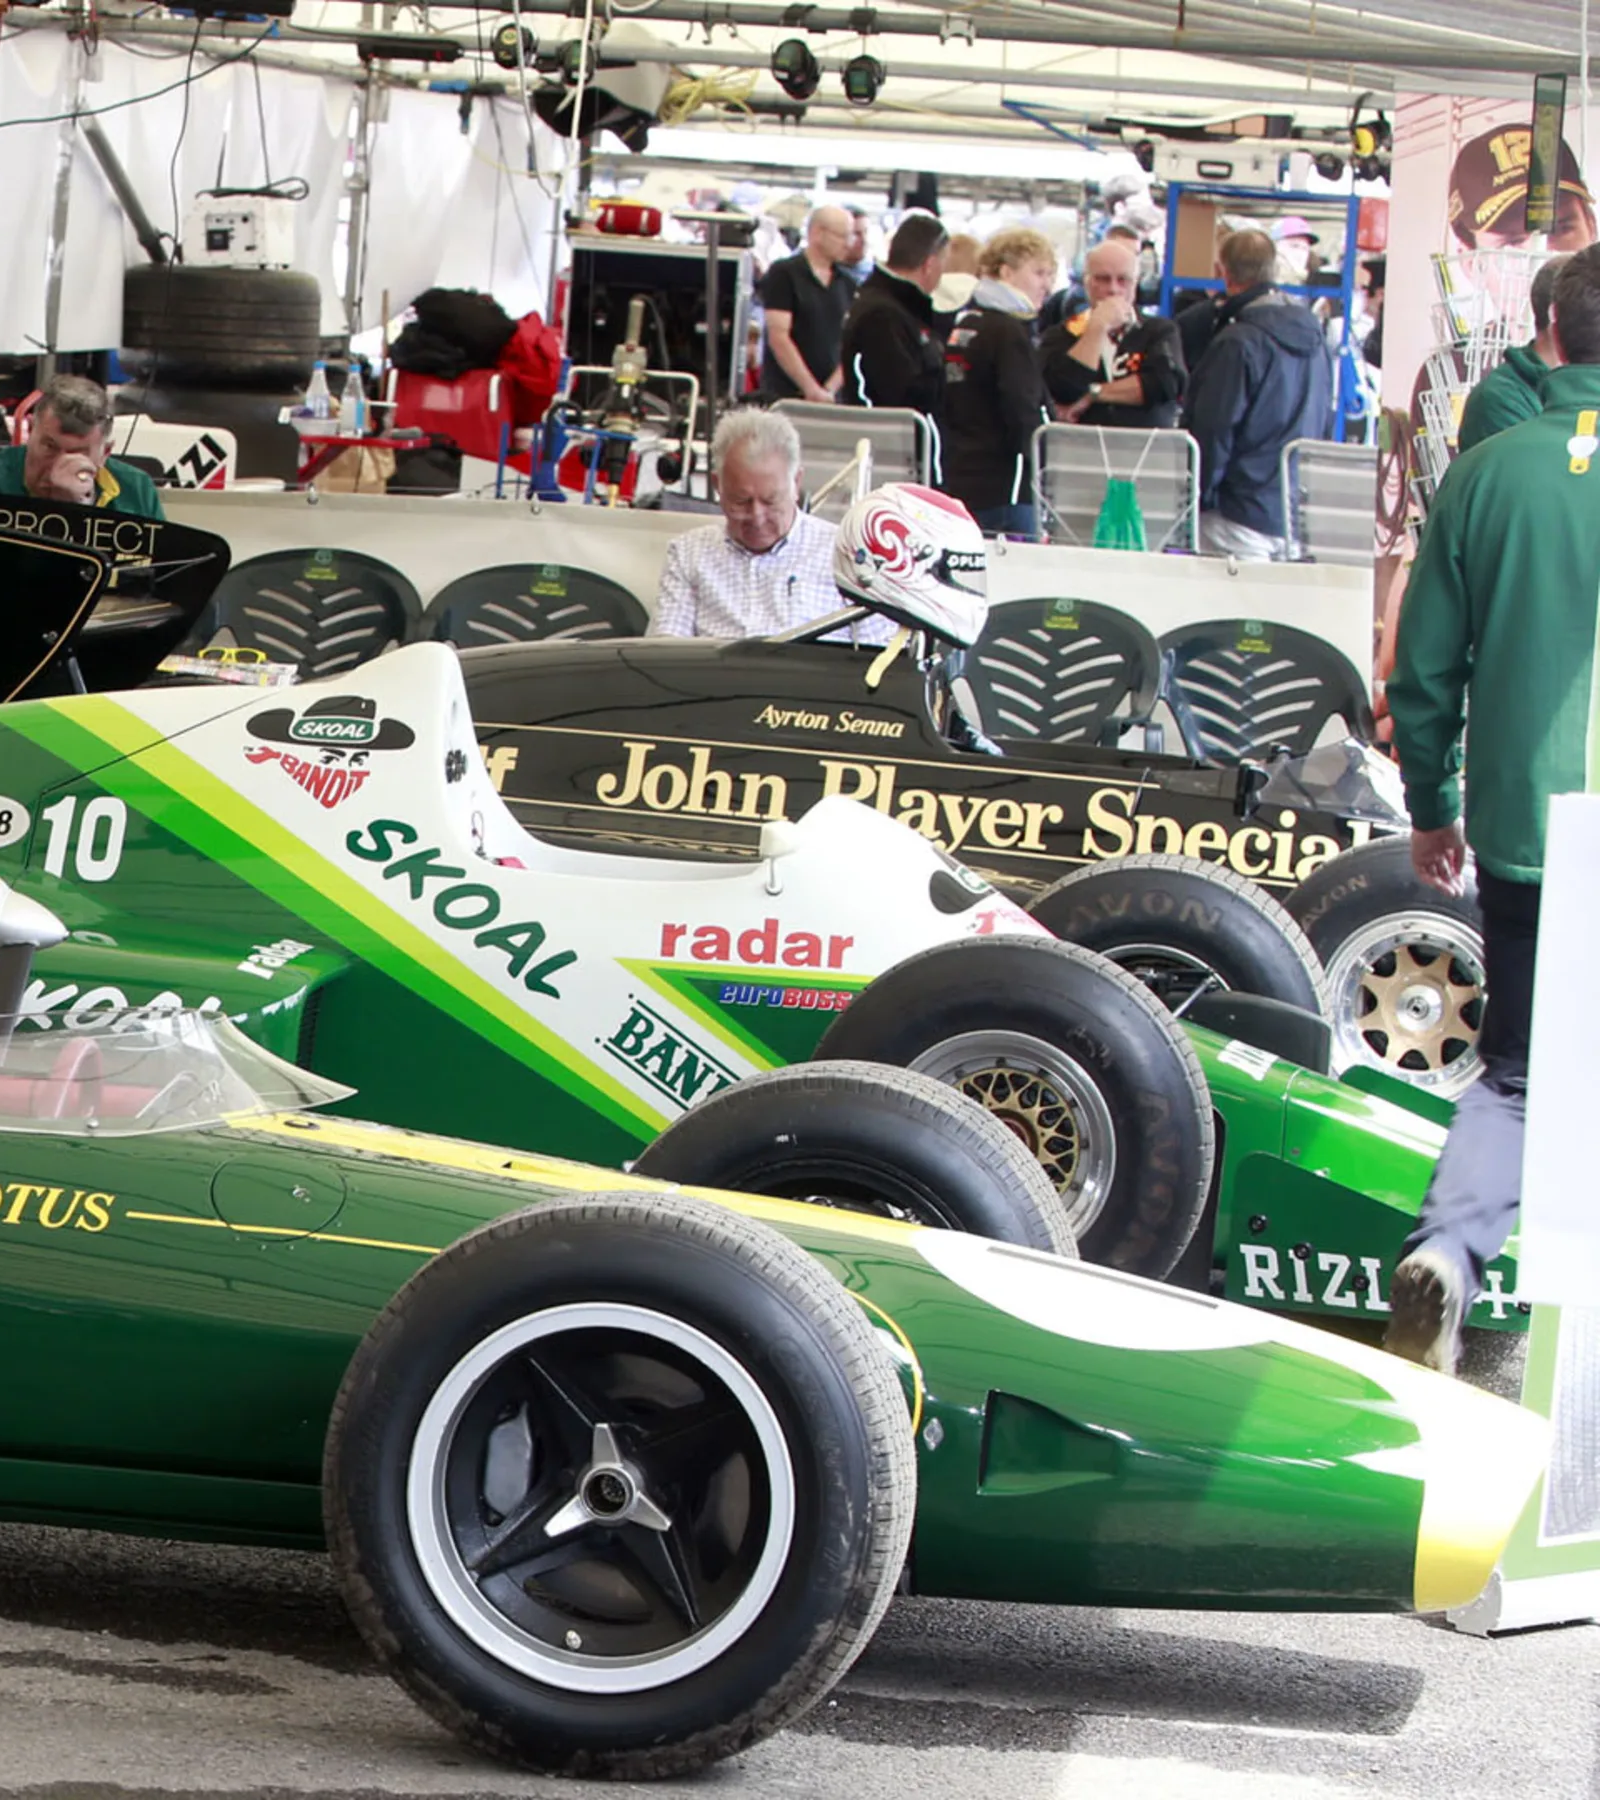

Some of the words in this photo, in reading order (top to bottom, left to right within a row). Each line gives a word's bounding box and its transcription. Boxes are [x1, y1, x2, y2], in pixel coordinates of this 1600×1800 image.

[298, 721, 367, 738] SKOAL
[753, 704, 830, 729] Ayrton
[834, 711, 905, 738] Senna
[279, 752, 371, 809] BANDIT
[596, 741, 789, 822] John
[818, 759, 1065, 853] Player
[42, 795, 128, 882] 10
[346, 819, 578, 1000] SKOAL
[1065, 889, 1224, 935] AVON
[1302, 872, 1371, 933] AVON
[236, 938, 315, 980] radar
[660, 918, 854, 969] radar
[1238, 1243, 1394, 1313] RIZL
